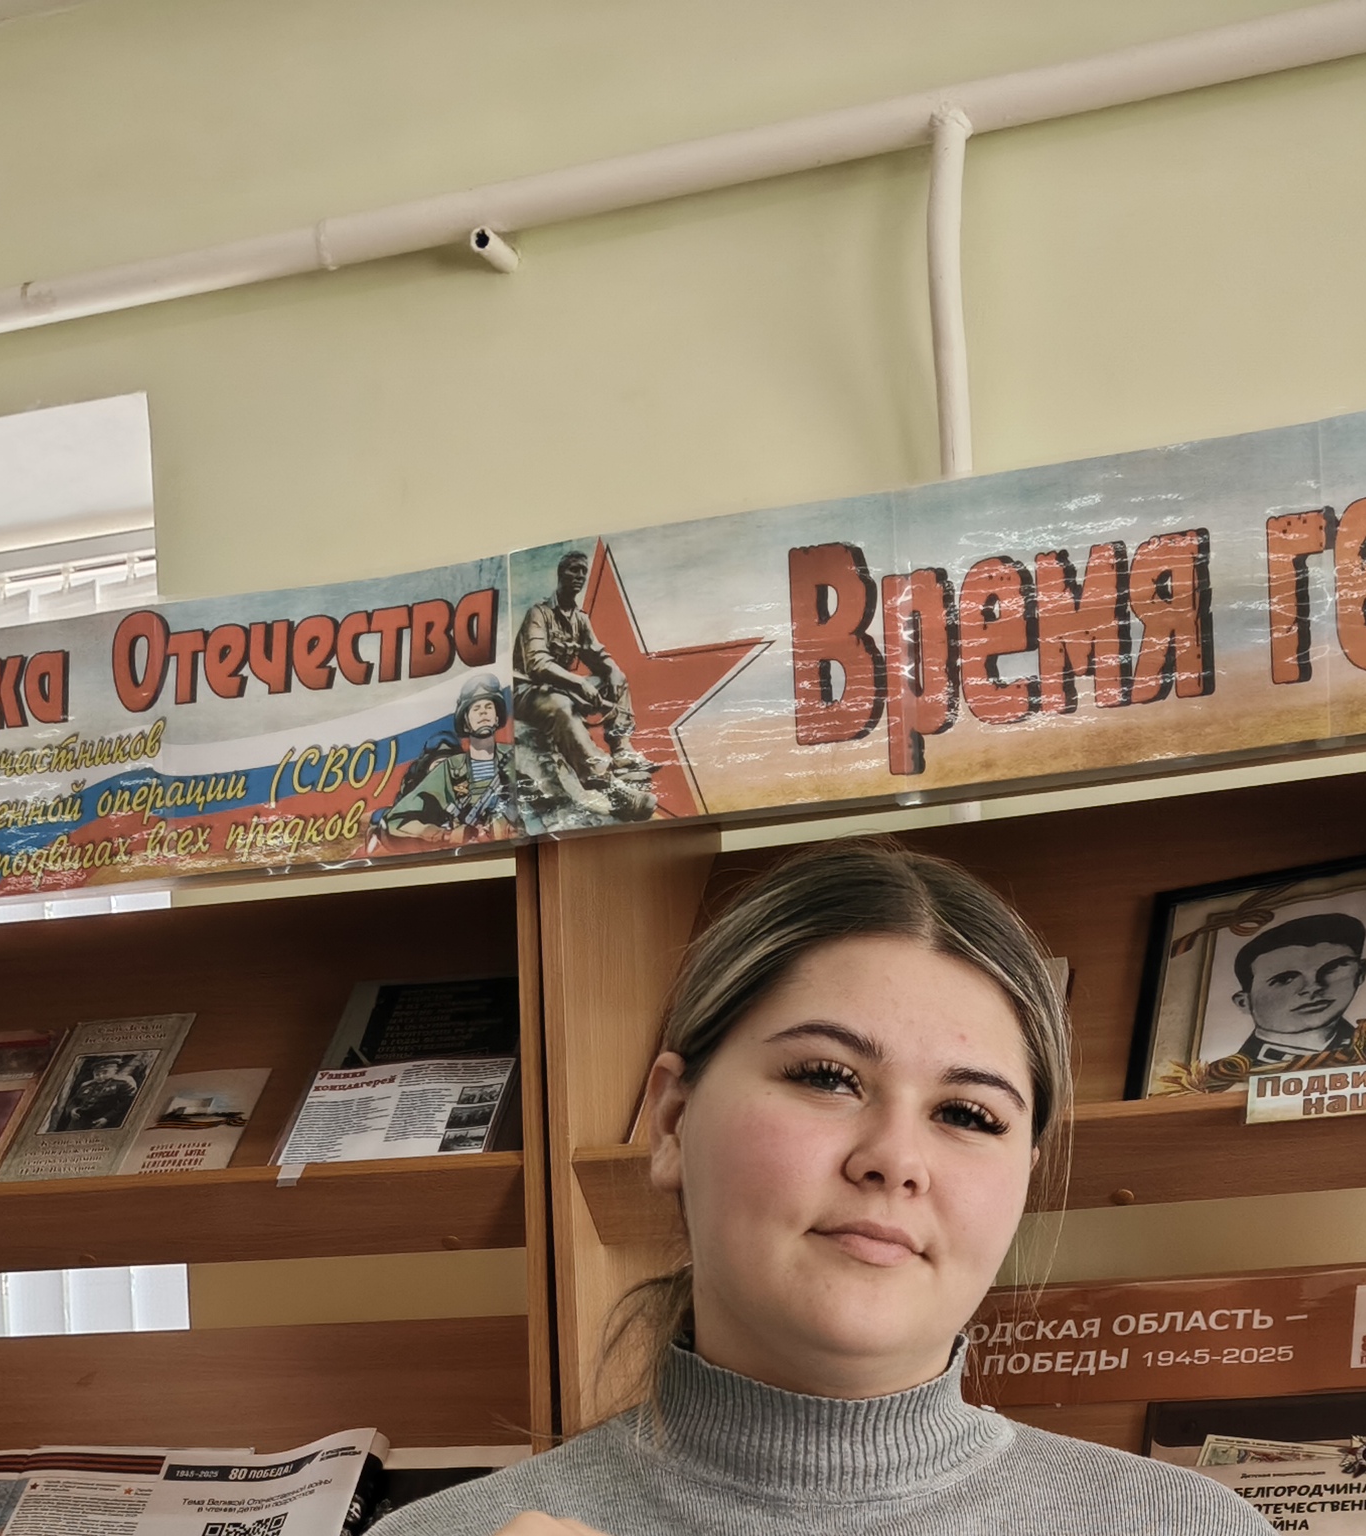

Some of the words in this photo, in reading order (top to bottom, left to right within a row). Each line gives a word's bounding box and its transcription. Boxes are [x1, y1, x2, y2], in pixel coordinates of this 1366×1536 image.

[112, 589, 497, 712] Отечества
[789, 528, 1216, 775] Время
[97, 770, 248, 824] операции
[270, 738, 398, 809] (СВО)
[146, 819, 211, 860] всех
[225, 798, 366, 863] предков
[965, 1317, 1101, 1347] ОДСКАЯ
[1112, 1308, 1275, 1337] ОБЛАСТЬ
[983, 1348, 1129, 1377] ПОБЕДЫ
[1142, 1345, 1295, 1369] 1945-2025
[228, 1467, 247, 1481] 80
[247, 1465, 295, 1480] ПОБЕДА!
